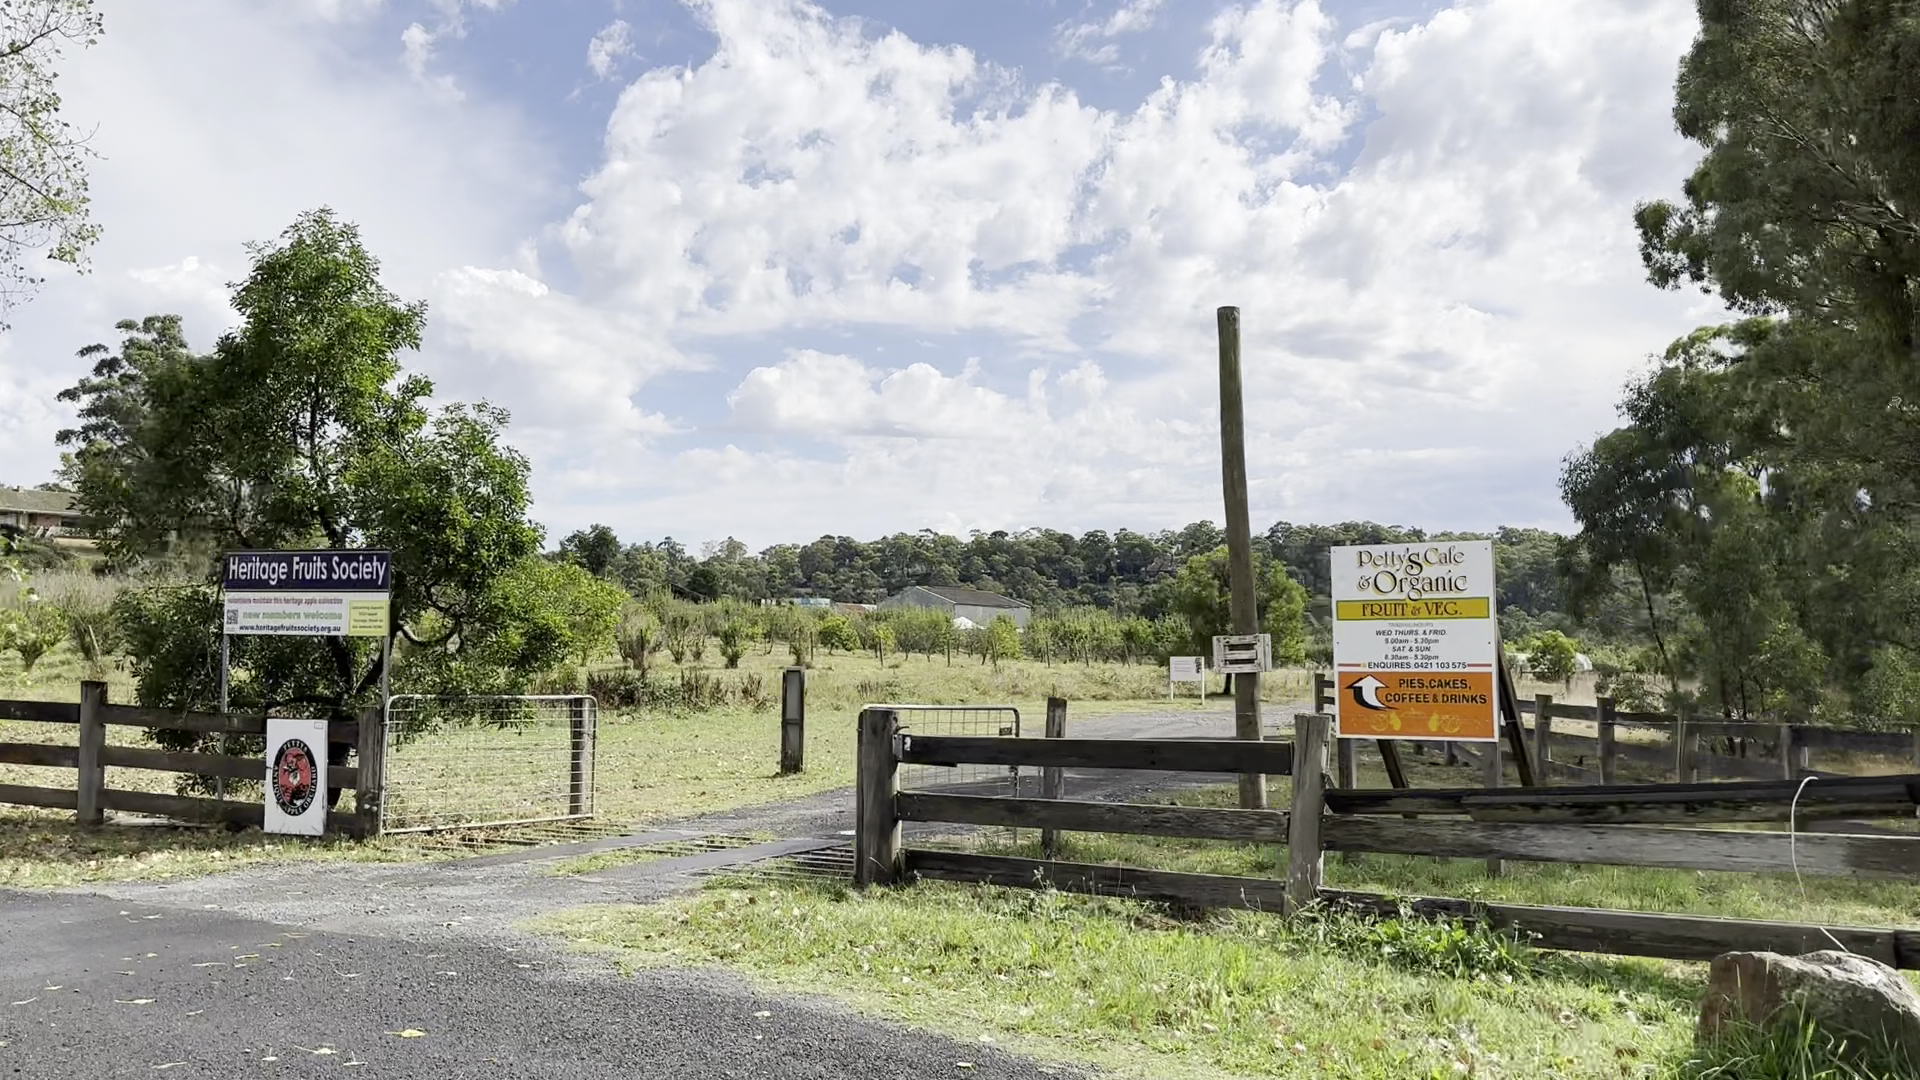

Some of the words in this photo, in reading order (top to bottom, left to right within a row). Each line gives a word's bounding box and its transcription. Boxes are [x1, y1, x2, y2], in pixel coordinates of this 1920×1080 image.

[1356, 548, 1423, 576] Petty's
[1424, 545, 1465, 565] Cafe
[229, 556, 288, 585] Heritage
[292, 556, 328, 580] Fruits
[331, 555, 387, 585] Society
[1357, 574, 1371, 590] &
[1373, 569, 1468, 601] Organic
[242, 612, 261, 620] new
[262, 611, 301, 620] members
[302, 611, 343, 620] welcome
[1361, 602, 1408, 617] FRUIT
[1410, 606, 1422, 617] &
[1423, 602, 1463, 616] VEG.
[239, 624, 342, 633] www.heritagefruitssociety.org.au
[1413, 661, 1433, 669] 0421
[1435, 661, 1451, 669] 103
[1451, 661, 1467, 669] 575
[1384, 692, 1430, 704] COFFEE
[1432, 693, 1440, 703] &
[1441, 693, 1487, 705] DRINKS
